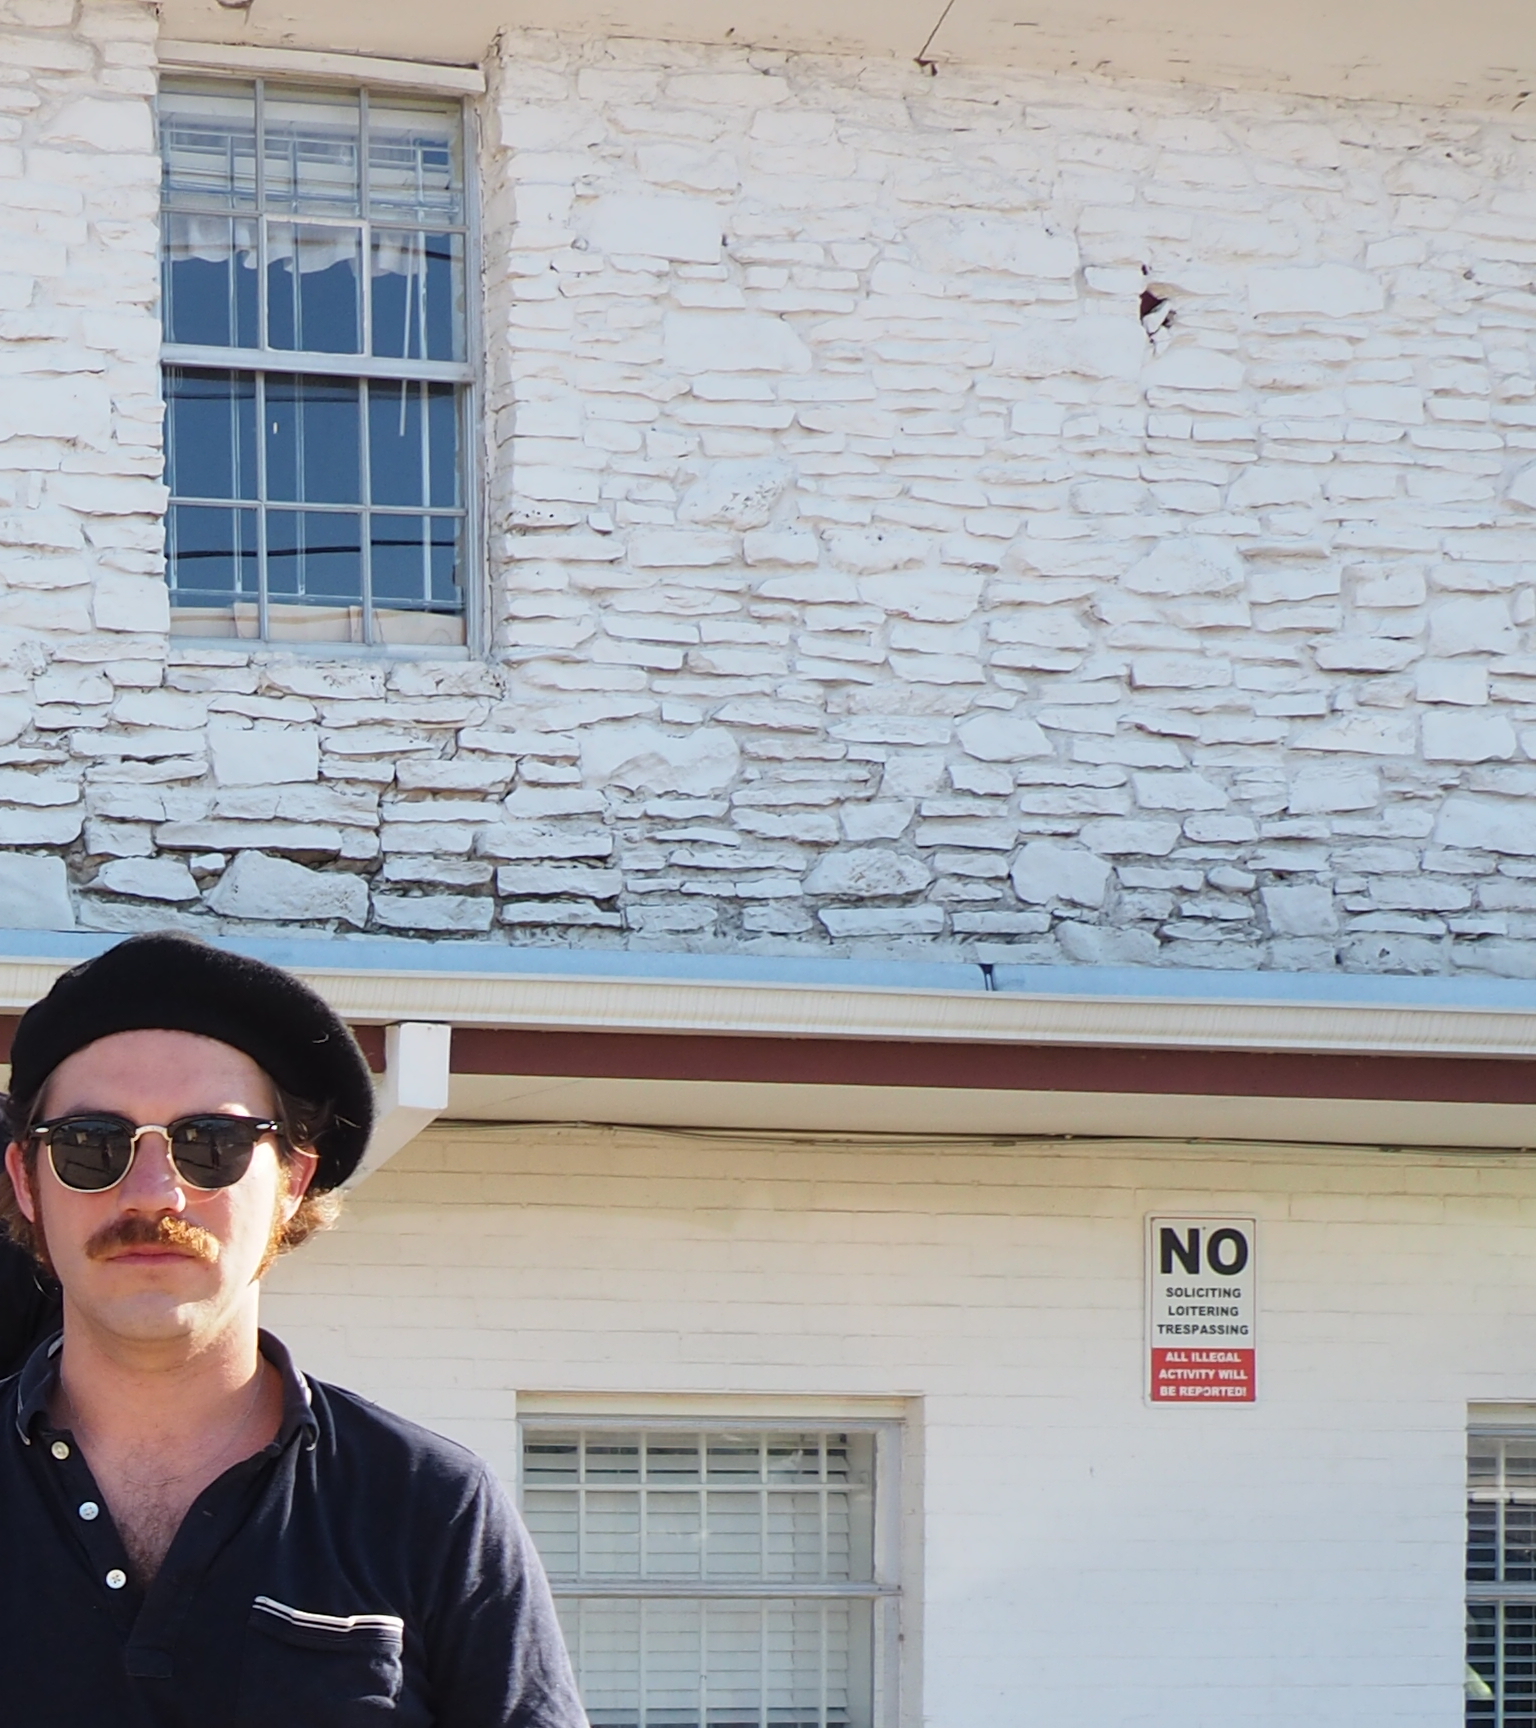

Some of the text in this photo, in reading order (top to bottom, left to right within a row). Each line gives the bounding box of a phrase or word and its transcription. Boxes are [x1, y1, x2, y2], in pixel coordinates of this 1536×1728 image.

[1159, 1227, 1249, 1276] NO
[1165, 1286, 1242, 1299] SOLICITING
[1167, 1305, 1239, 1317] LOITERING
[1157, 1323, 1250, 1335] TRESPASSING
[1165, 1351, 1242, 1363] ALL ILLEGAL
[1158, 1368, 1248, 1380] ACTIVITY WILL
[1159, 1385, 1247, 1398] BE REPORTED!
